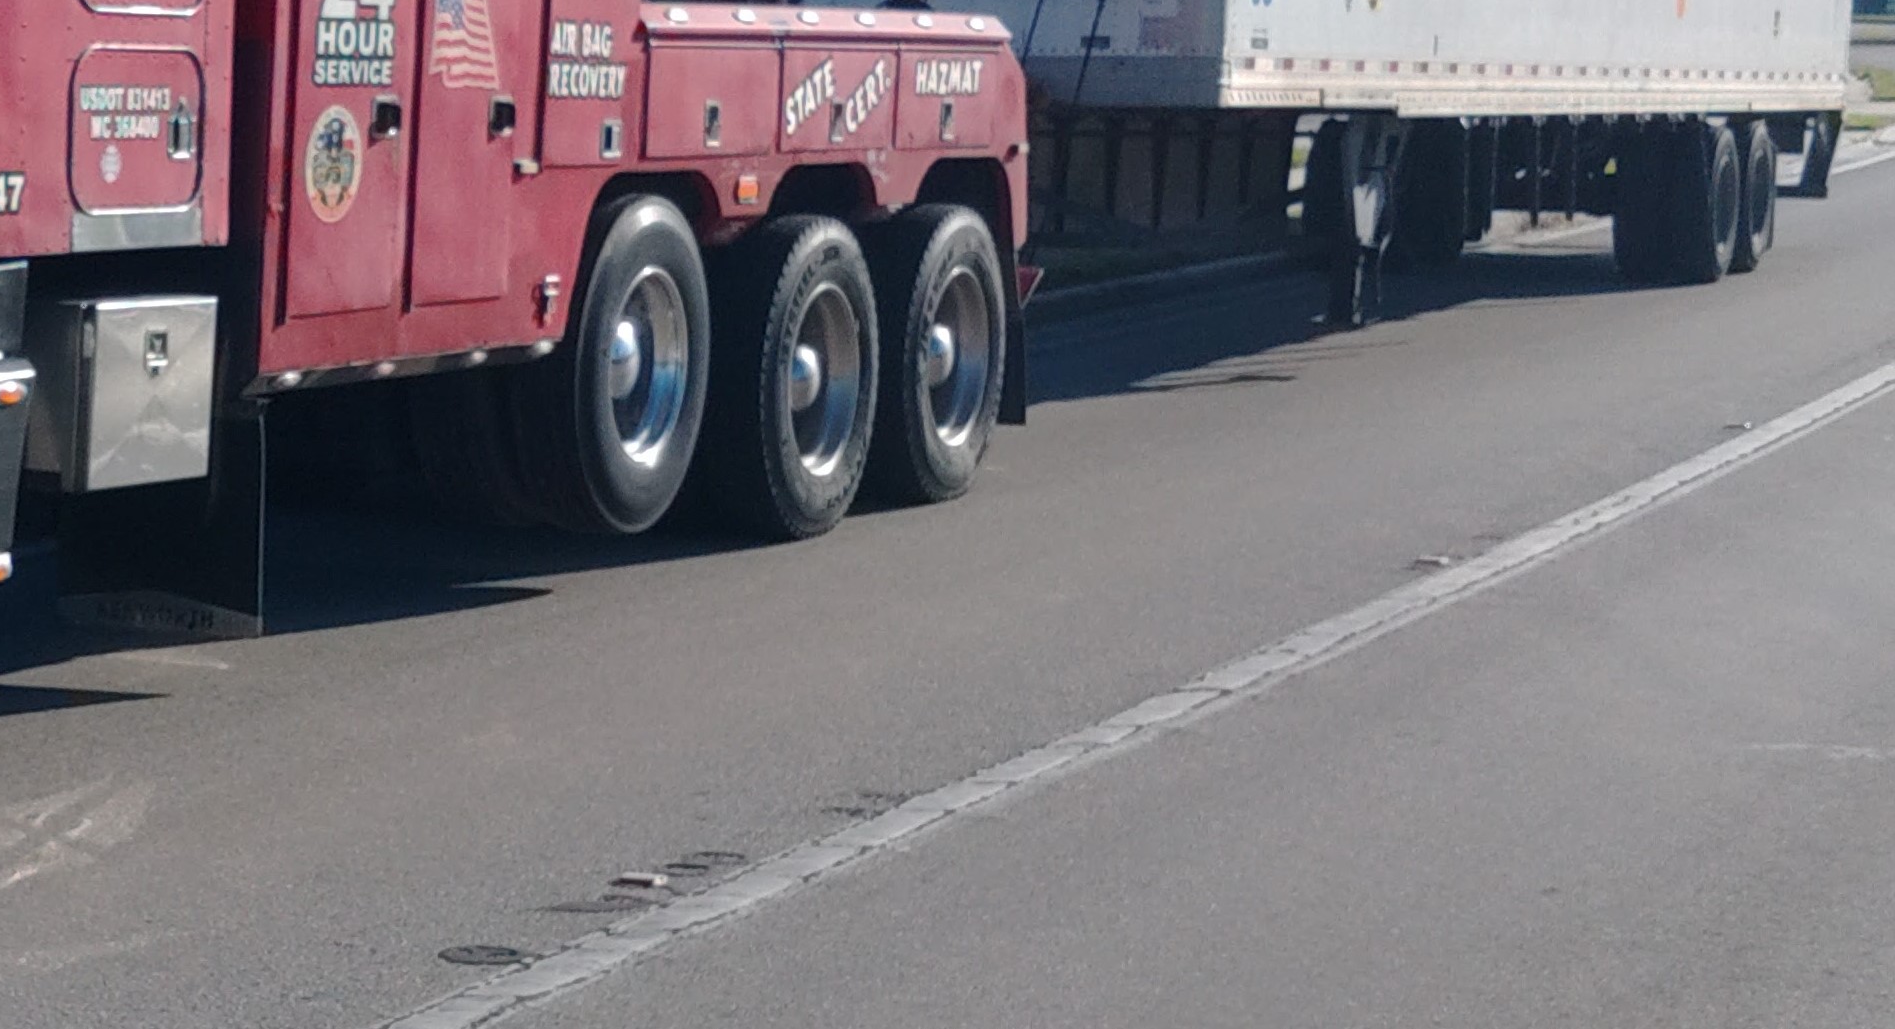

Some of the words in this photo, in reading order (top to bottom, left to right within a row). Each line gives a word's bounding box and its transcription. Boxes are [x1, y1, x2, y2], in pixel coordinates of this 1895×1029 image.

[317, 21, 394, 56] HOUR
[551, 21, 577, 57] AIR
[581, 22, 613, 58] BAG
[313, 59, 393, 86] SERVICE
[548, 61, 627, 98] RECOVERY
[80, 84, 124, 111] USDOT
[785, 56, 835, 137] STATE
[844, 56, 891, 134] CERT.
[915, 58, 984, 97] HAZMAT
[90, 115, 112, 139] MC
